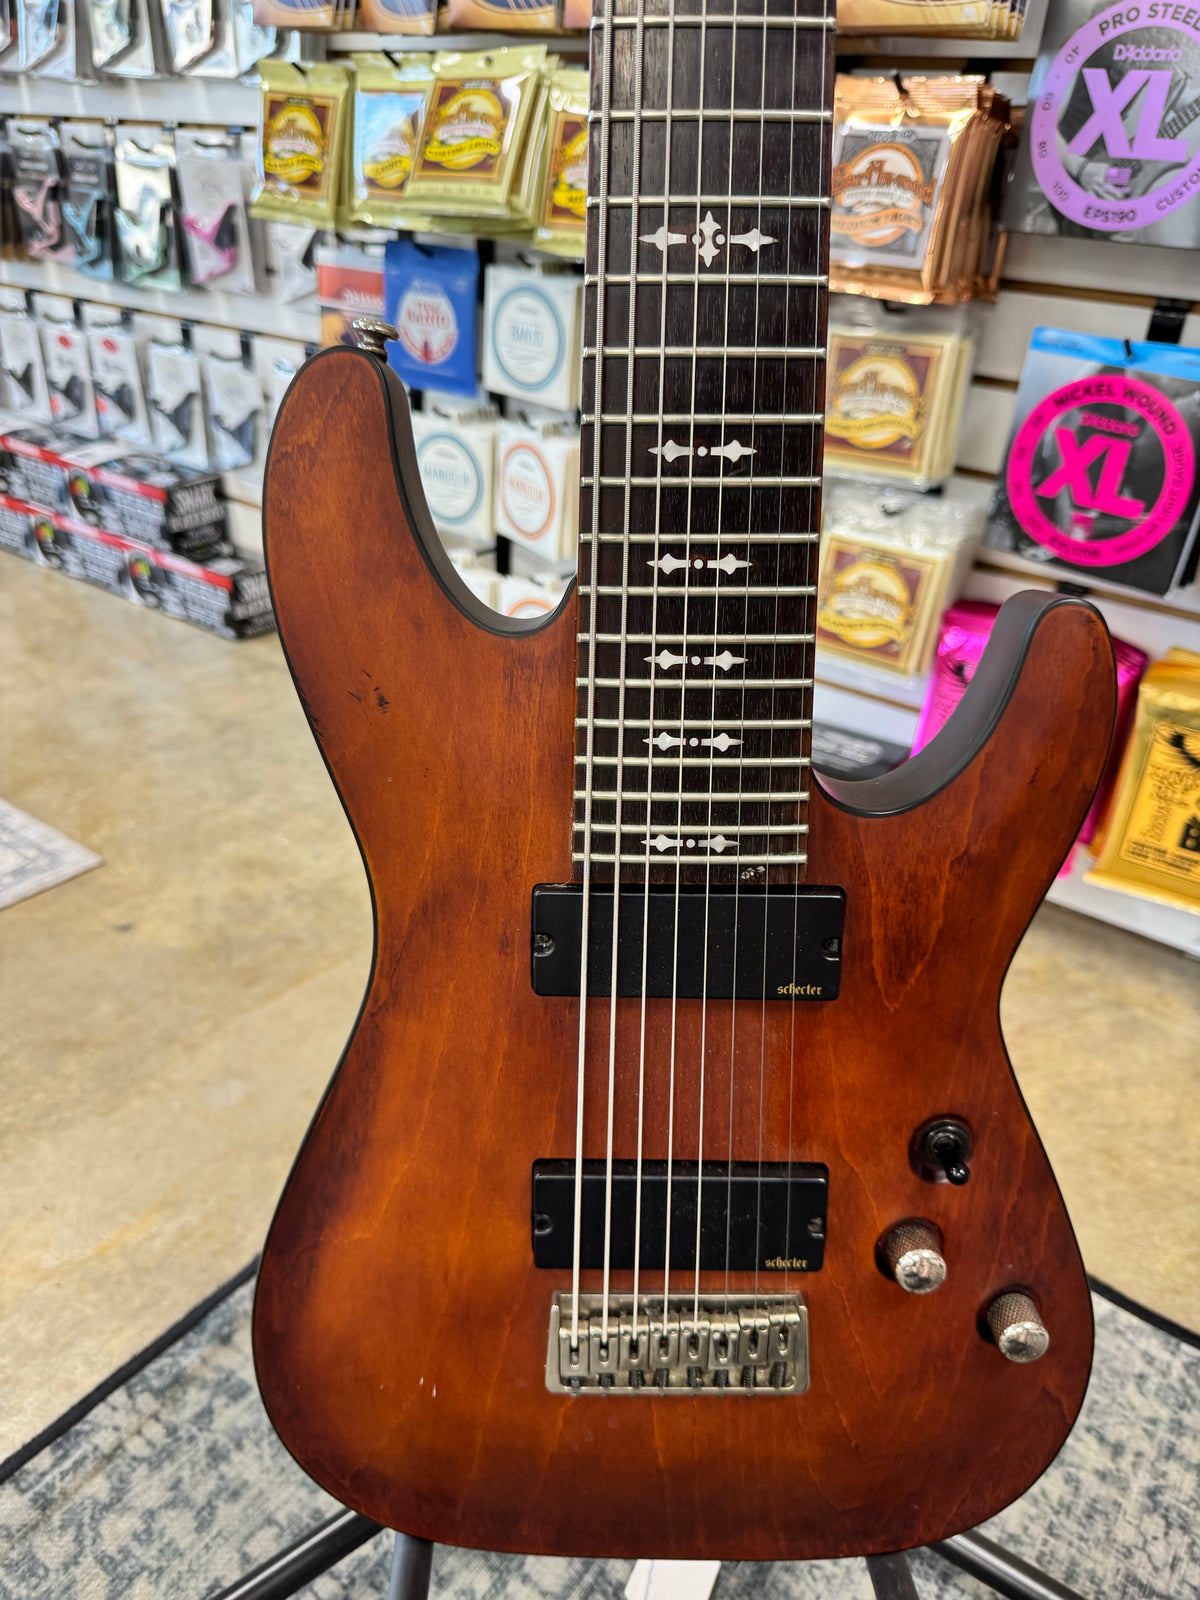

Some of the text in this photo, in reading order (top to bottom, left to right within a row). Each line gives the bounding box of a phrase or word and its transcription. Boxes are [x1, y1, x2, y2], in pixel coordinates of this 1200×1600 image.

[1098, 6, 1141, 37] PRO
[1065, 68, 1190, 162] XL
[1155, 168, 1200, 211] CUSTO
[1053, 383, 1177, 437] NICKEL WOUND
[1035, 425, 1146, 520] XL
[777, 982, 822, 996] schecter
[765, 1256, 808, 1269] schecter
